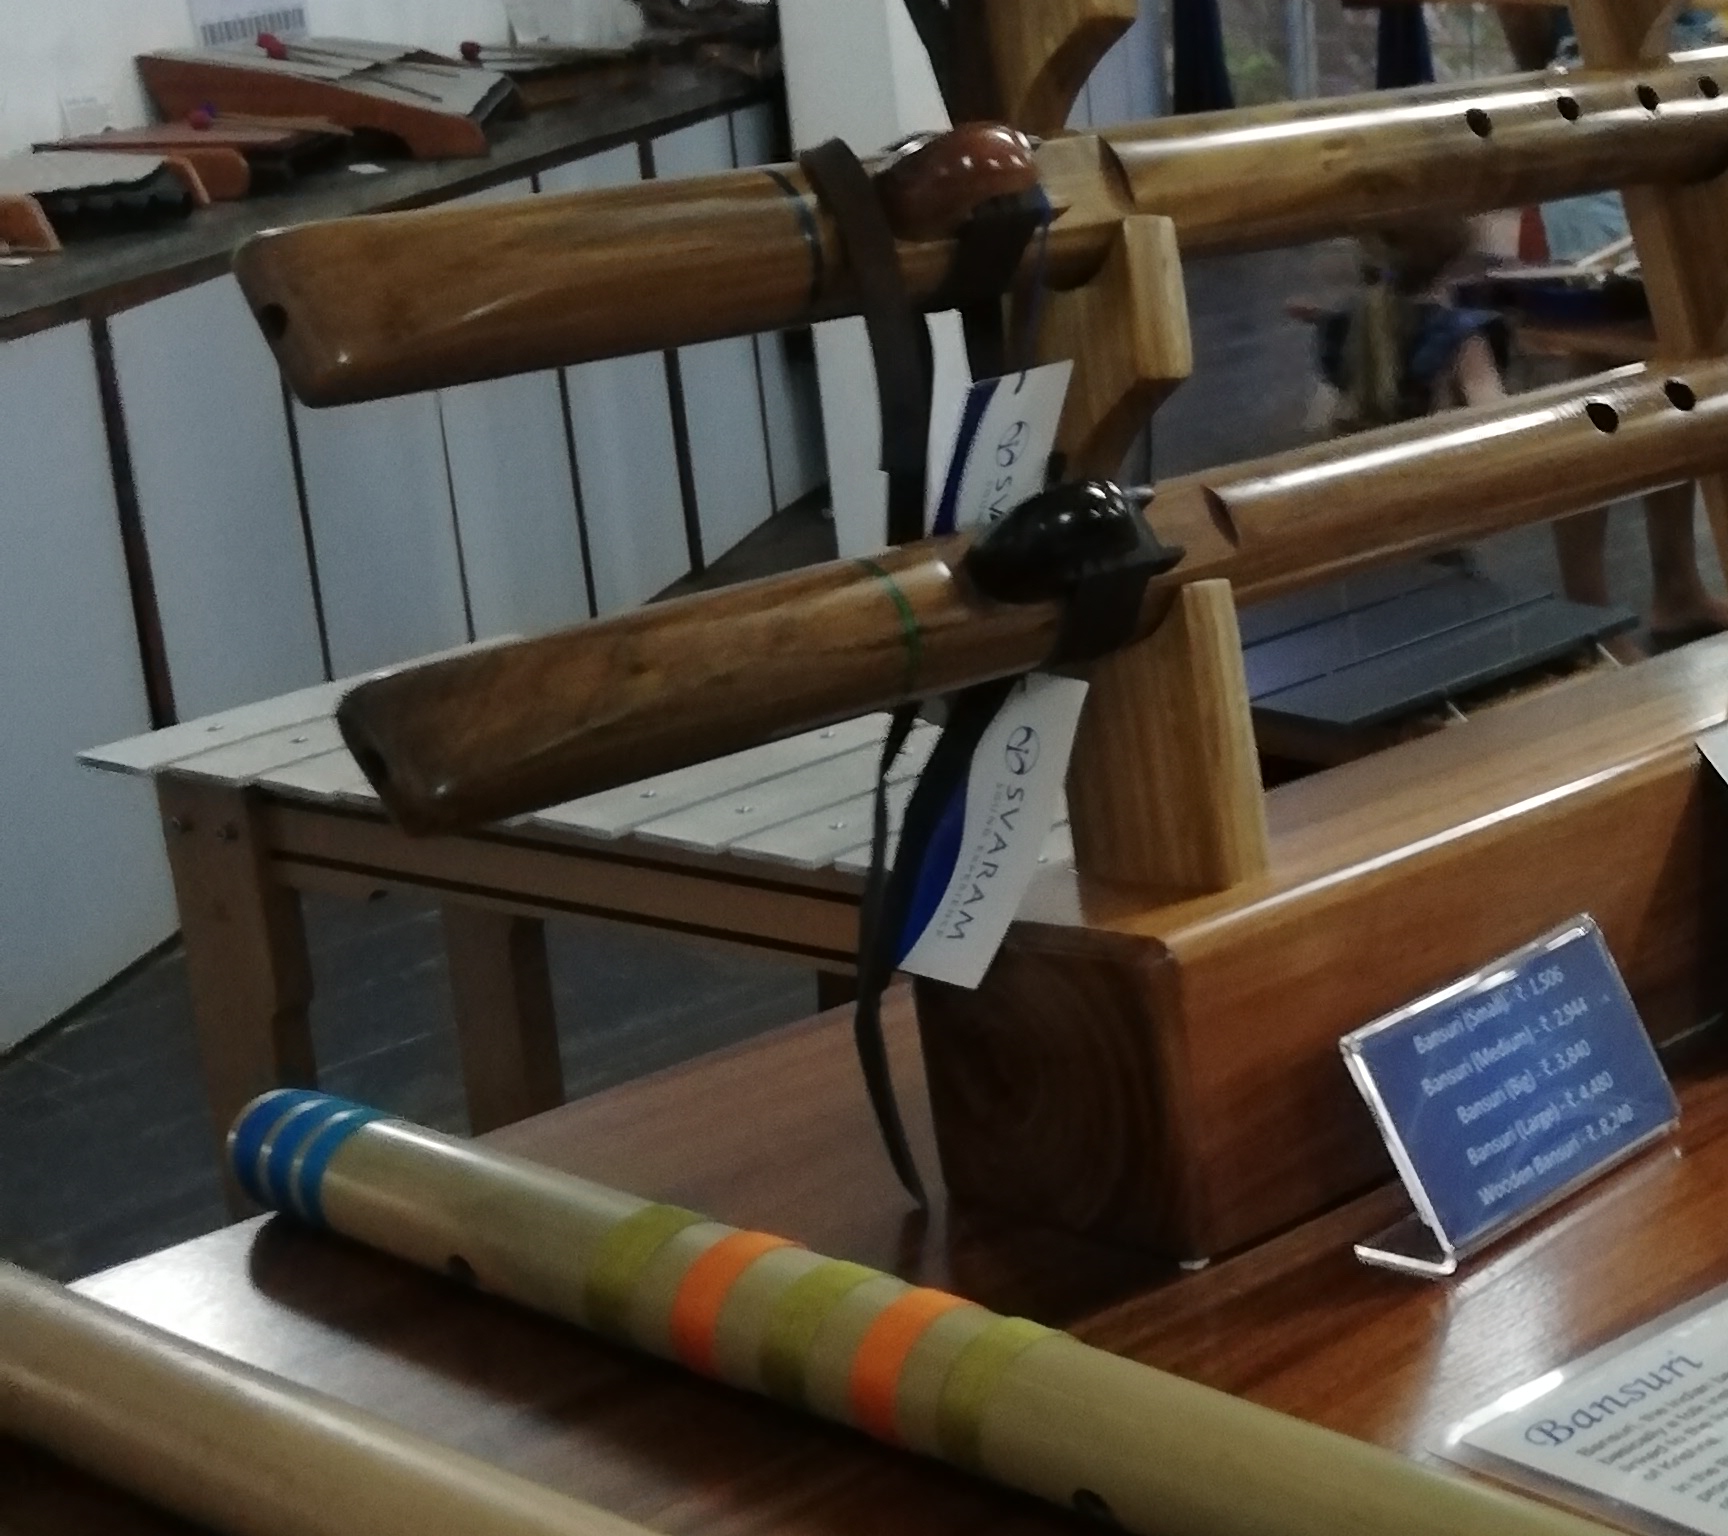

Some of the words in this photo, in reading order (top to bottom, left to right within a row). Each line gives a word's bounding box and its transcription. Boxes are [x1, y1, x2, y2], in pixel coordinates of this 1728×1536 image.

[946, 784, 1026, 942] SVARAM
[1413, 1019, 1464, 1054] Bansuri
[1420, 1061, 1473, 1096] Bansuri
[1456, 1089, 1507, 1124] Bansuri
[1466, 1127, 1517, 1165] Bansuri
[1524, 1356, 1701, 1445] Bansuri
